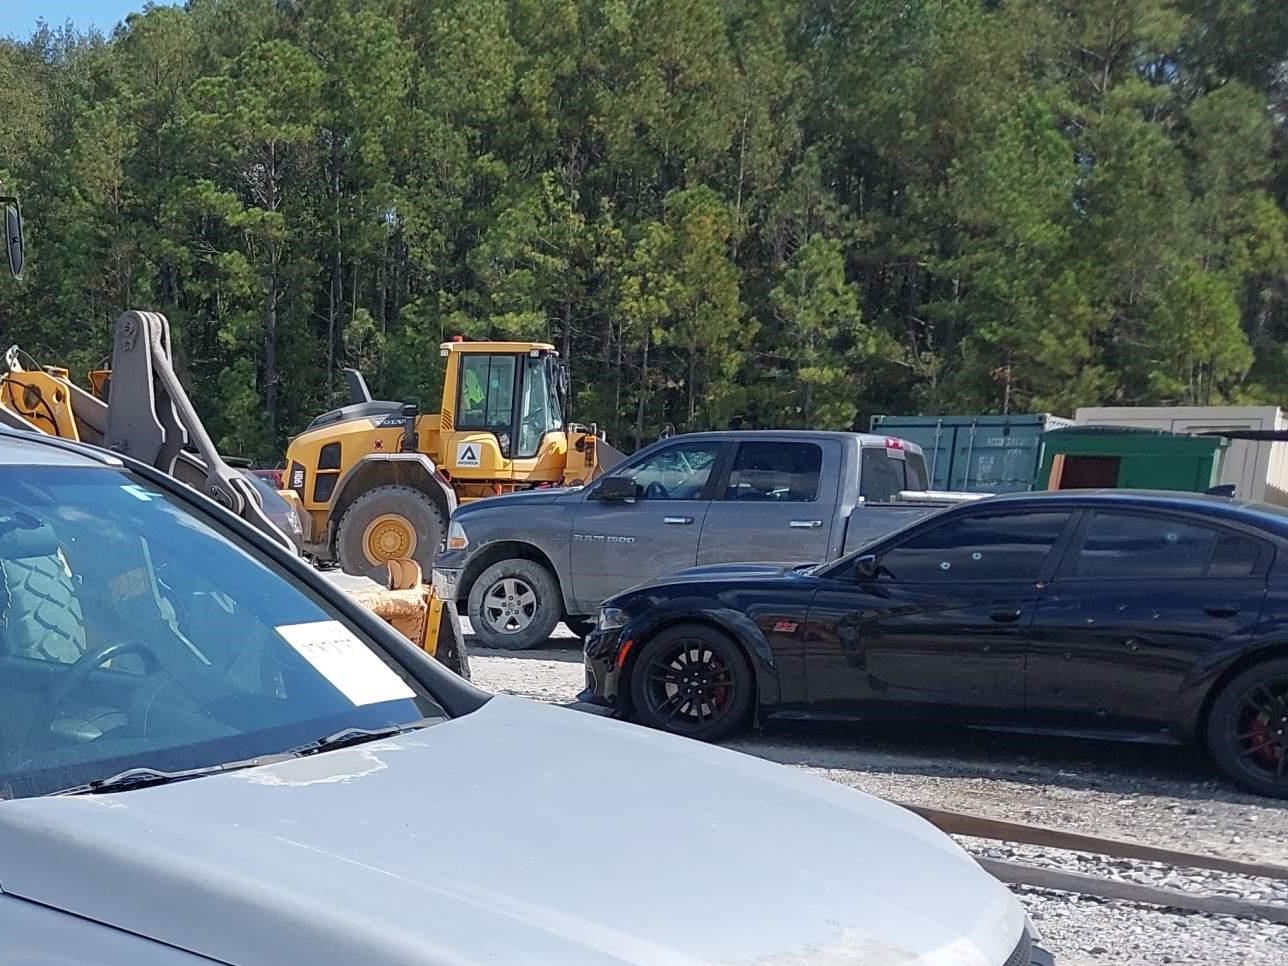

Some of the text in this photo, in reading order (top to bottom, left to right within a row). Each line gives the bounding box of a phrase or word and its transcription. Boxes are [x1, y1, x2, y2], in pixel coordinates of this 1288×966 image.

[293, 470, 304, 488] L90H
[572, 534, 605, 543] RAM
[607, 535, 635, 543] 1500
